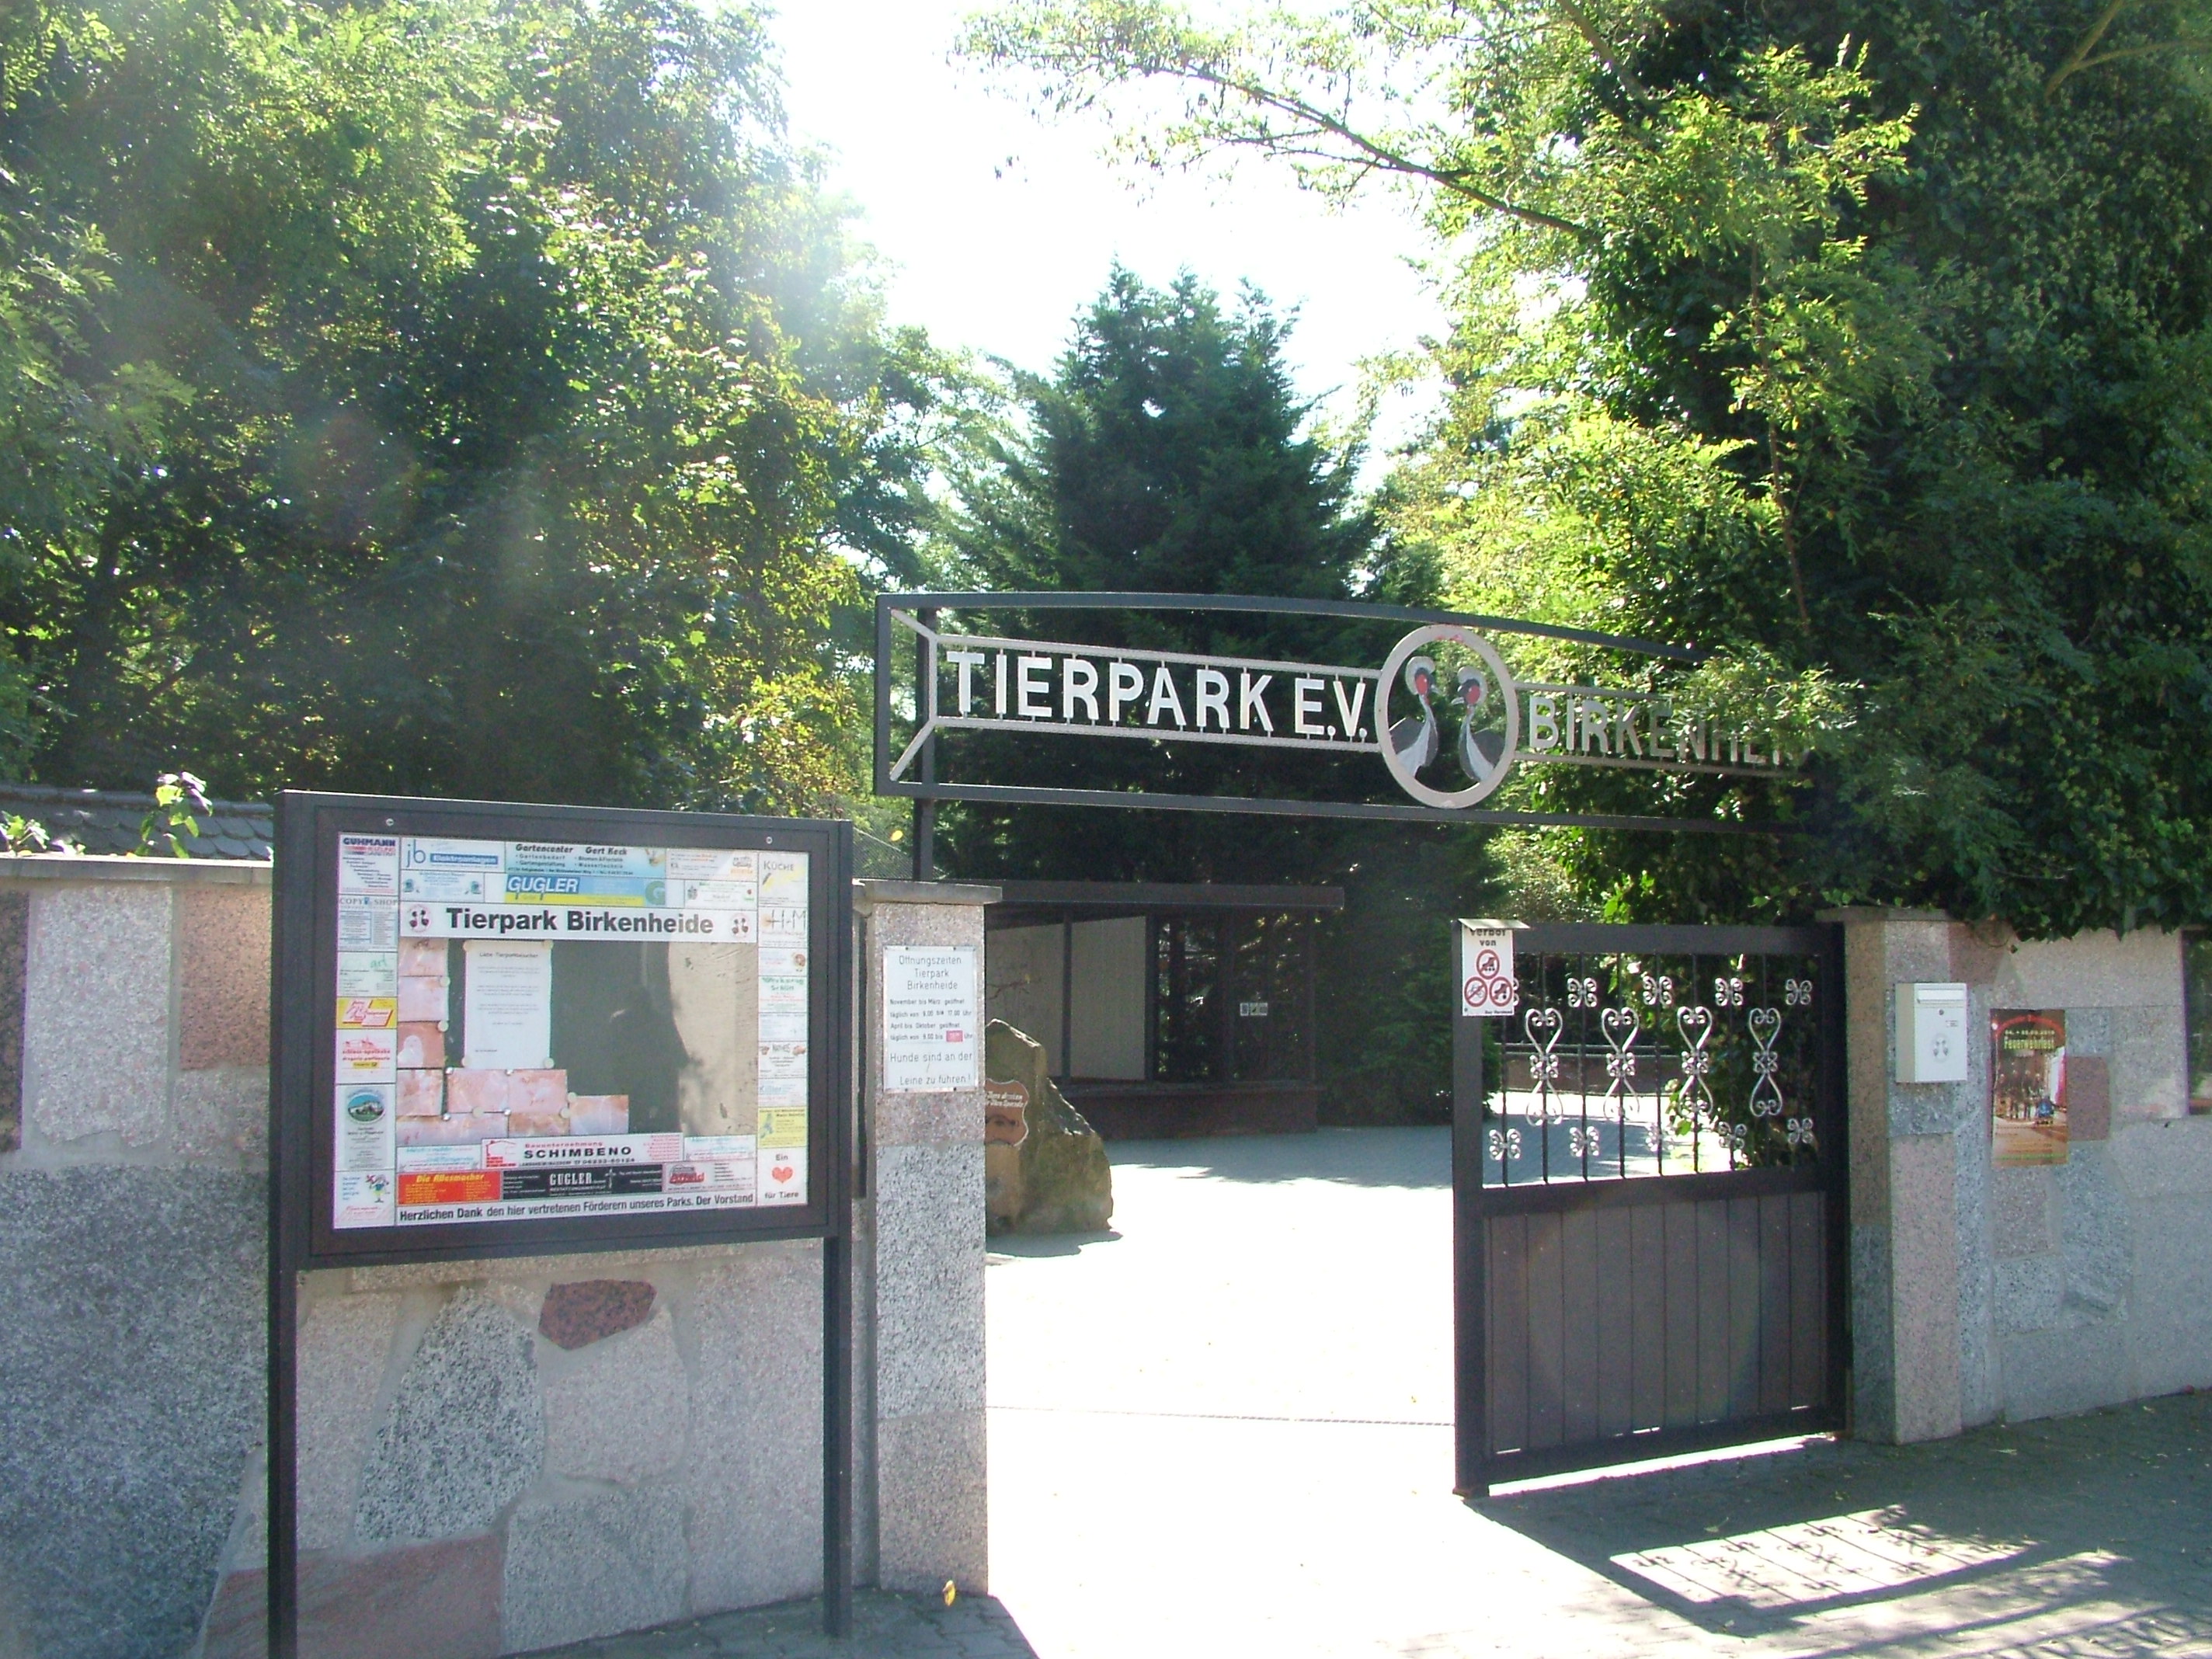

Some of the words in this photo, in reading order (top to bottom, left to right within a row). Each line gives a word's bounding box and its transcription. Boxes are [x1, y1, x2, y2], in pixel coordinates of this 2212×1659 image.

[947, 652, 1274, 732] TIERPARK
[516, 843, 574, 854] Gartencenter
[507, 875, 579, 894] GUGLER
[446, 907, 558, 934] Tierpark
[567, 910, 714, 934] Birkenheide
[915, 969, 949, 979] Tierpark
[907, 980, 958, 990] Birkenheide
[890, 1052, 920, 1063] Hunde
[923, 1052, 941, 1062] sind
[958, 1051, 972, 1061] der
[900, 1076, 923, 1086] Leine
[523, 1146, 632, 1159] SCHIMBENO
[549, 1172, 593, 1186] GUGLER
[400, 1209, 454, 1221] Herzlichen
[457, 1207, 483, 1218] Dank
[487, 1207, 505, 1217] den
[507, 1205, 525, 1216] hier
[529, 1203, 581, 1215] vertretenen
[583, 1200, 627, 1212] Förderern
[630, 1199, 665, 1209] unseres
[696, 1196, 711, 1205] Der
[715, 1193, 753, 1205] Vorstand
